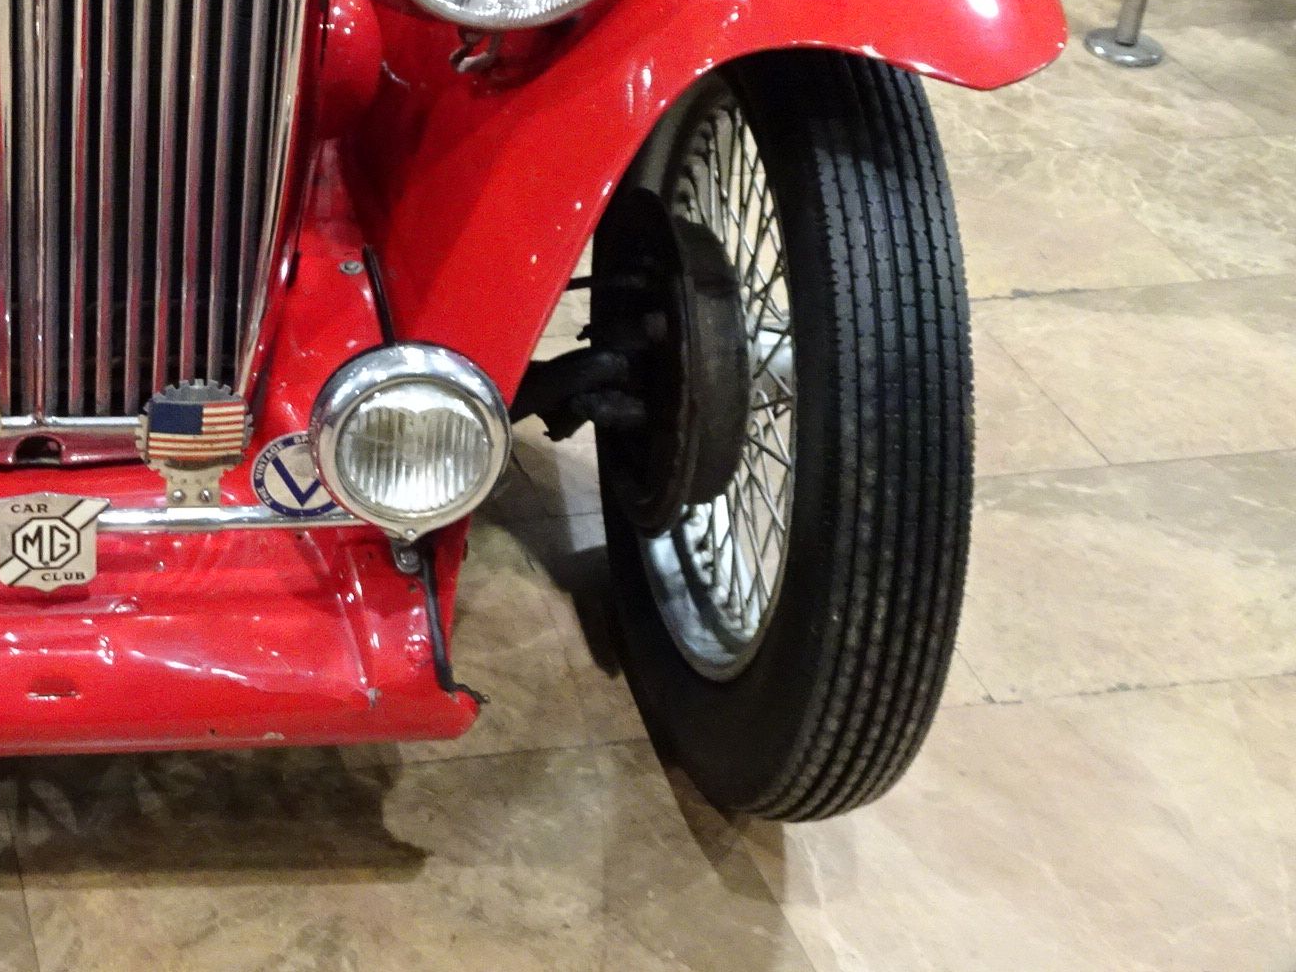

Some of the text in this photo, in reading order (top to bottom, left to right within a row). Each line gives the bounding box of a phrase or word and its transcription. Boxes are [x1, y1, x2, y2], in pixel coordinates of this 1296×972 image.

[254, 440, 286, 481] VINTAGE
[10, 504, 49, 514] CAR
[22, 525, 71, 563] MG
[41, 572, 86, 582] CLUB
